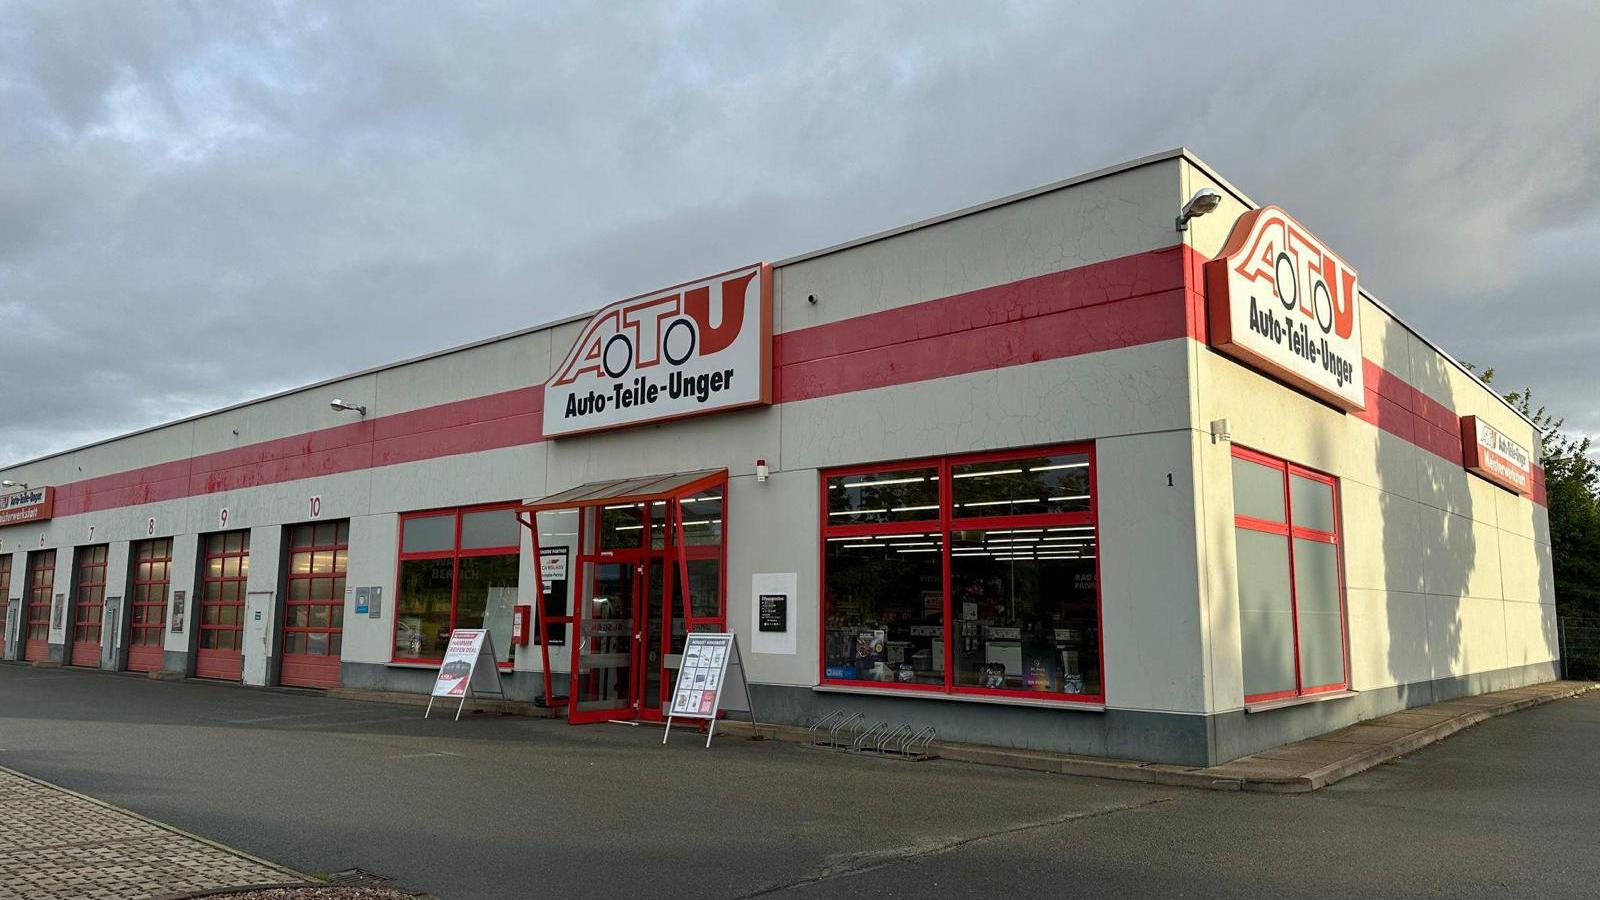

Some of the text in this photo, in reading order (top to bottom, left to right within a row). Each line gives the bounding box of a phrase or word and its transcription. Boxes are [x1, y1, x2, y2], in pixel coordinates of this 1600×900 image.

[1249, 296, 1353, 388] Auto-Teile-Unger
[565, 368, 734, 418] Auto-Teile-Unger
[1167, 473, 1174, 486] 1
[309, 497, 321, 516] 10
[221, 509, 228, 527] 9
[89, 527, 95, 542] 7
[148, 519, 154, 535] 8
[40, 533, 45, 547] 6
